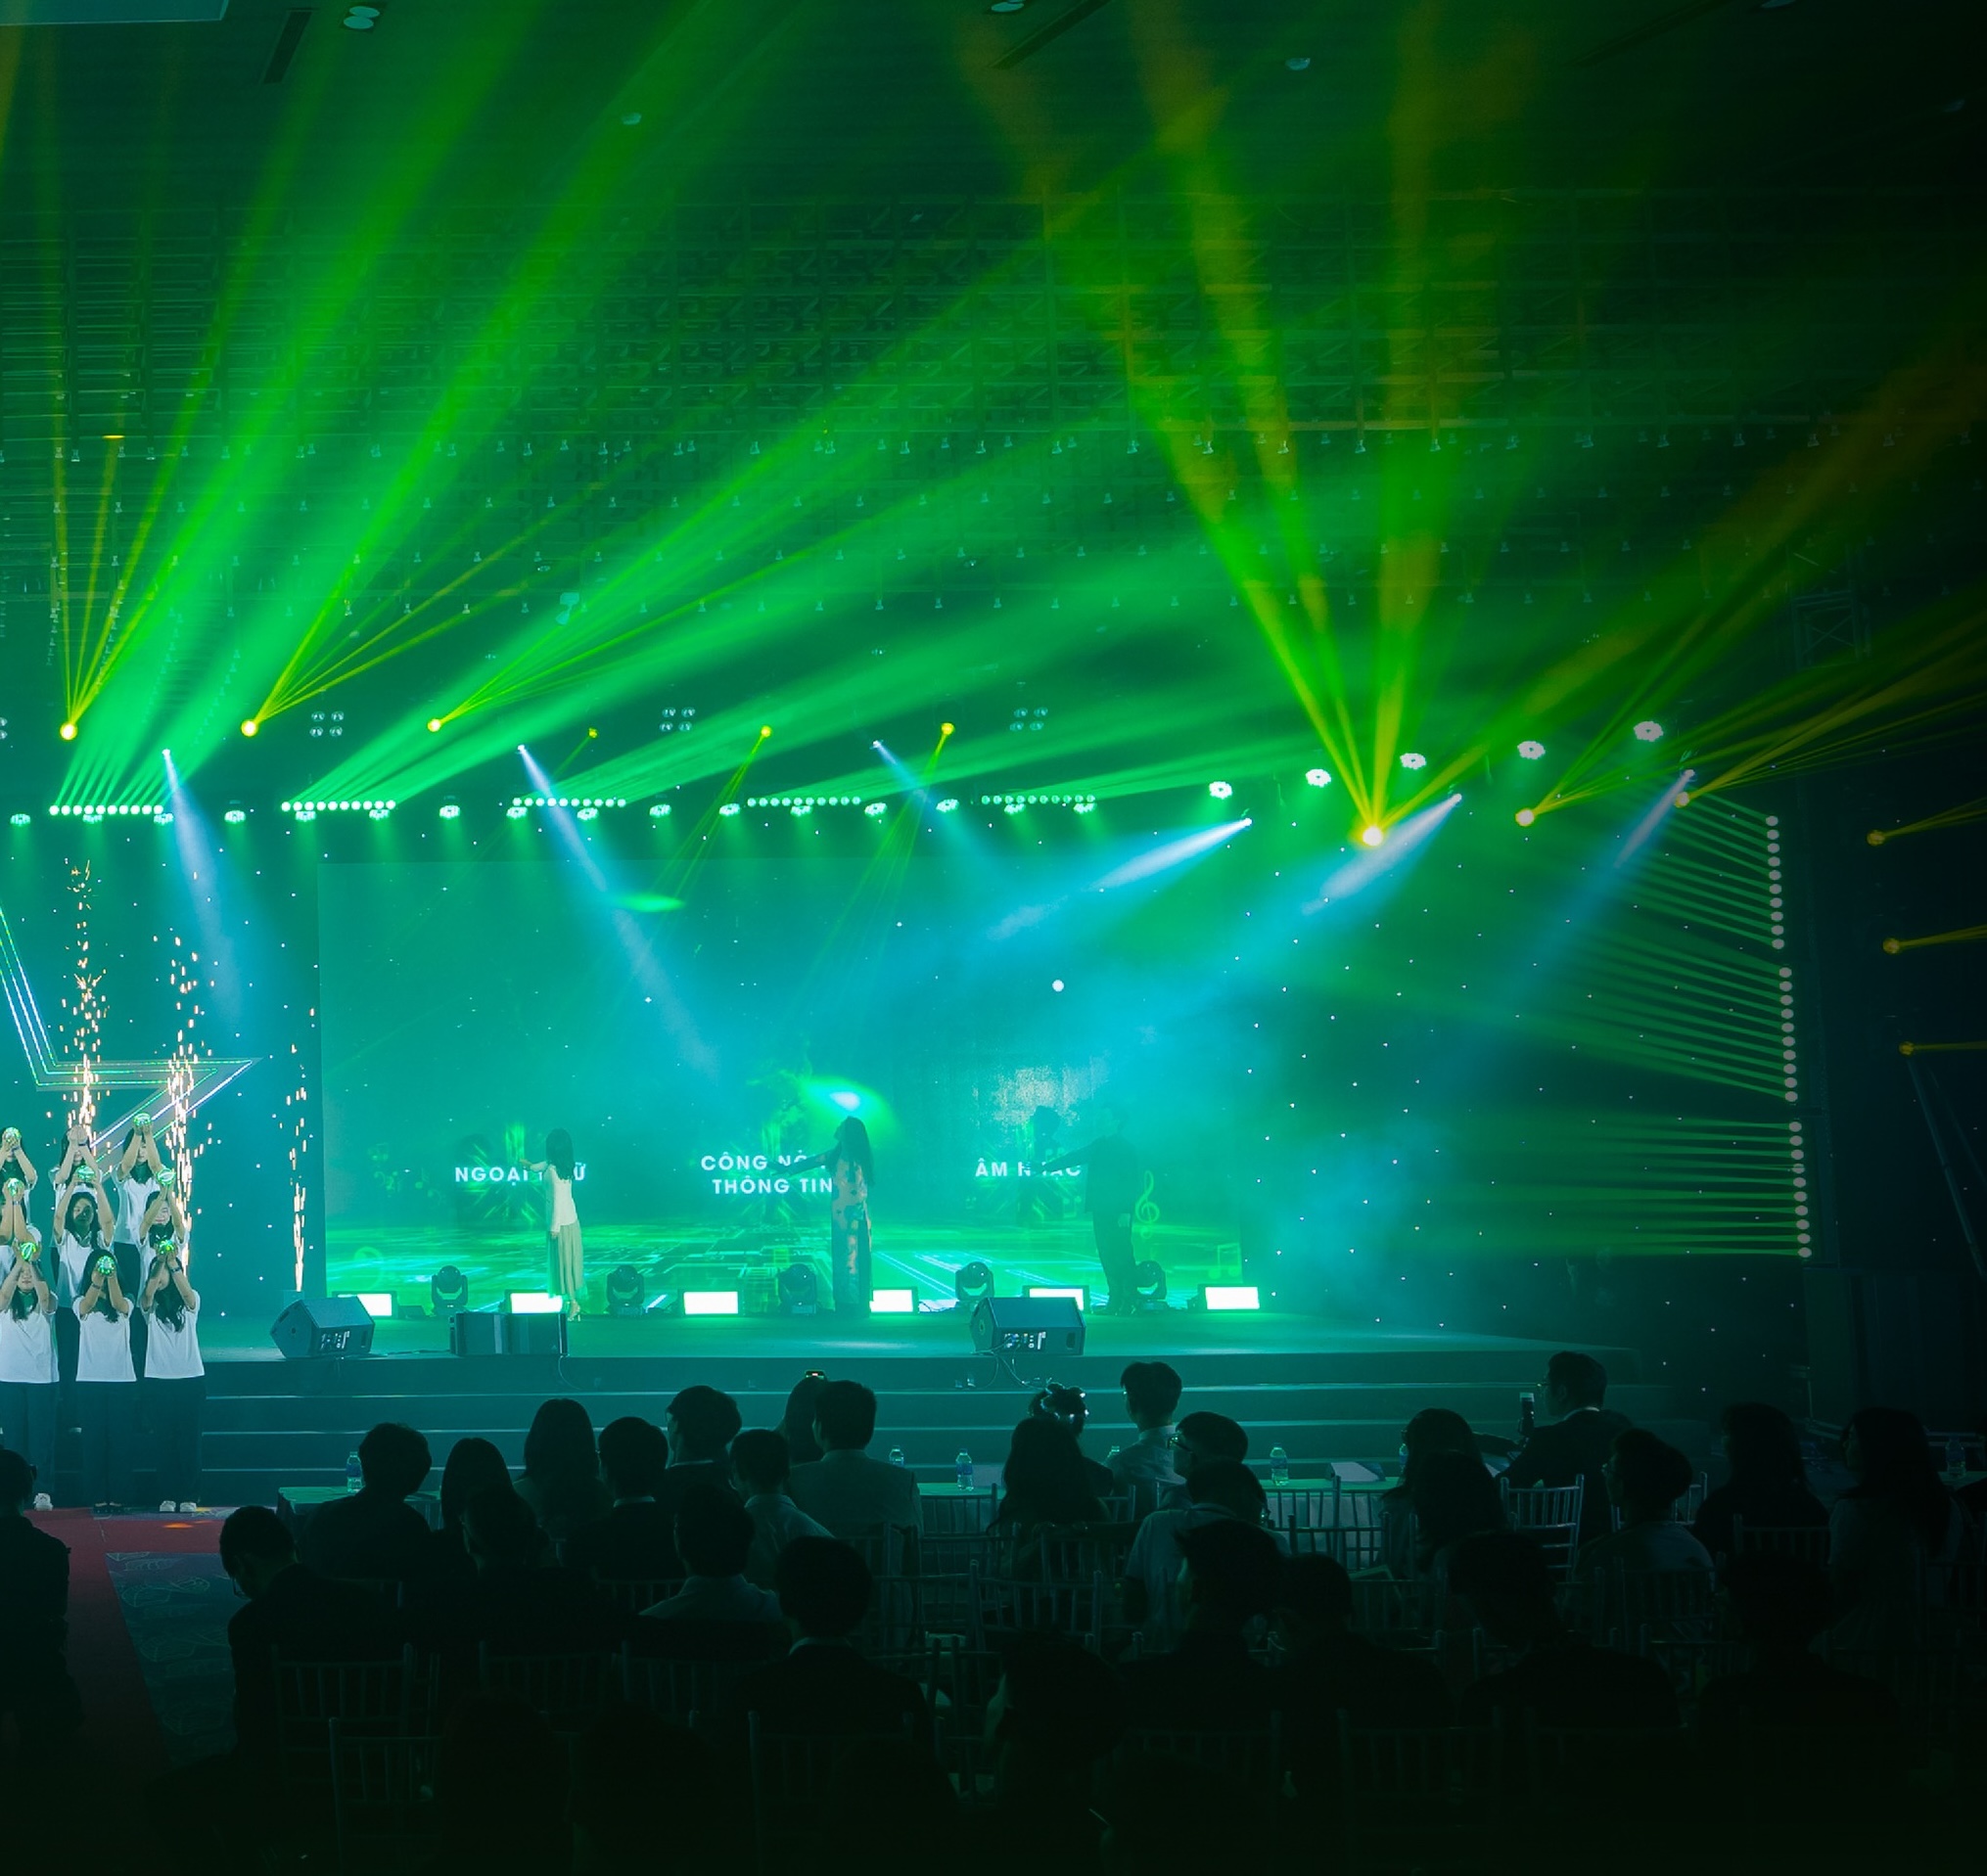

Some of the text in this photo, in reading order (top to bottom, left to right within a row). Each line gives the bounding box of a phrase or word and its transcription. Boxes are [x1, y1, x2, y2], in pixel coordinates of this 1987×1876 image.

[701, 1151, 768, 1170] CÔNG
[975, 1158, 1007, 1177] ÂM
[455, 1167, 529, 1186] NGOẠI
[712, 1175, 833, 1194] THÔNG TIN
